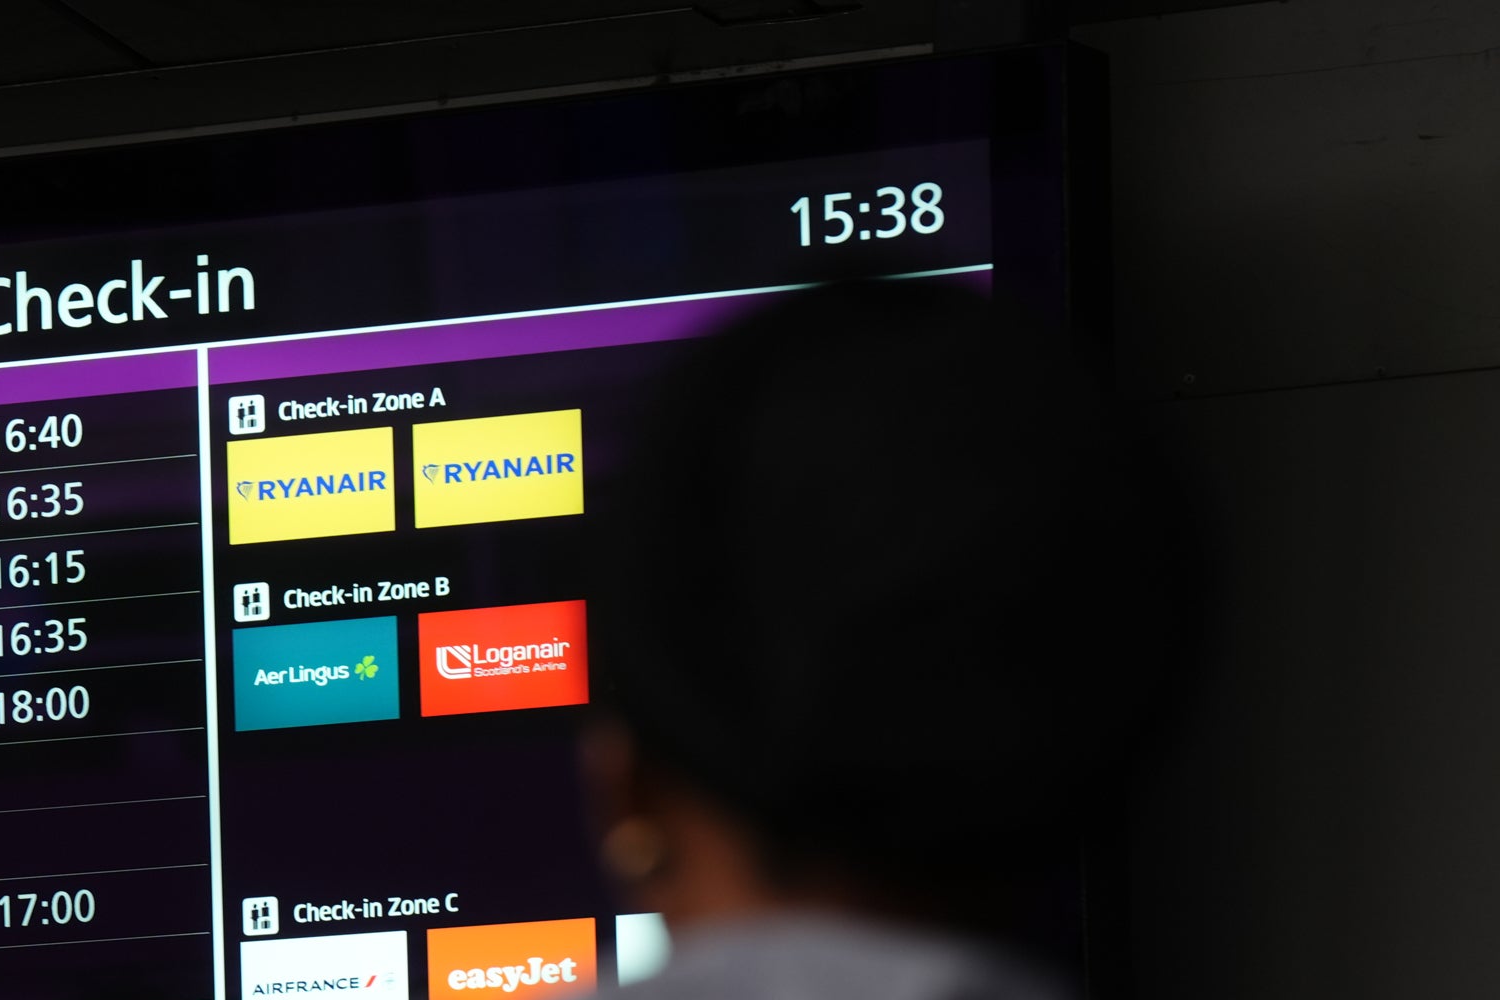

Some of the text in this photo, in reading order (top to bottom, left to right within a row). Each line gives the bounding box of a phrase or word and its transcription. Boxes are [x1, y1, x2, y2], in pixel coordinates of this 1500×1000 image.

[789, 181, 945, 248] 15:38
[278, 387, 447, 422] Check-in Zone A
[444, 452, 575, 484] RYANAIR
[257, 470, 387, 501] RYANAIR
[283, 576, 451, 610] Check-in Zone B
[473, 637, 571, 667] Loganair
[532, 662, 567, 672] Airline
[254, 665, 350, 687] Aer Lingus
[293, 892, 459, 924] Check-in Zone C
[253, 977, 359, 995] AIRFRANCE
[447, 956, 578, 993] easyJet
